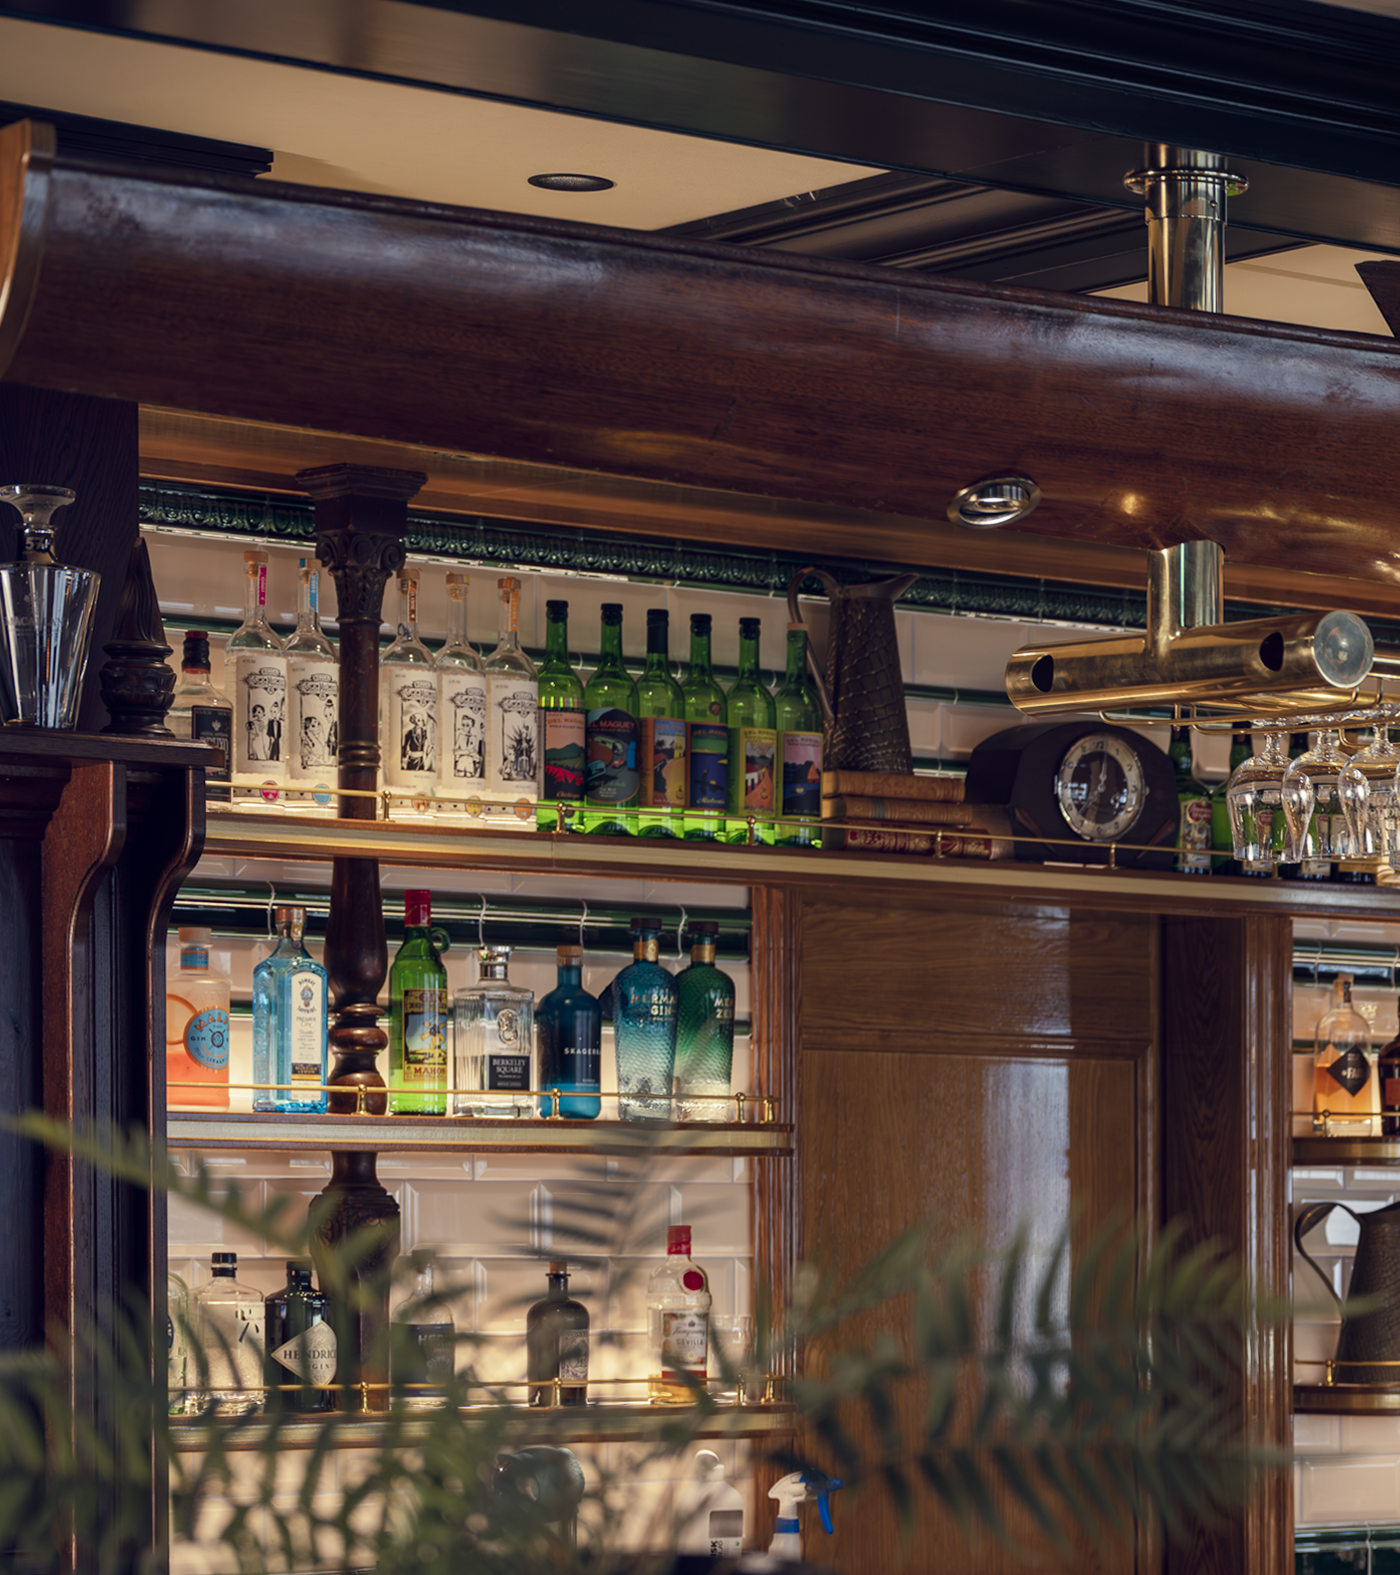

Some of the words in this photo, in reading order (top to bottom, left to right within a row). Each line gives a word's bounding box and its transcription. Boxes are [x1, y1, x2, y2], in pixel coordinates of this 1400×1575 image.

[600, 720, 635, 729] MAGUEY
[298, 978, 317, 987] BOMBAY
[419, 991, 443, 1002] GIN
[297, 1006, 317, 1015] SAPPHIRE
[650, 1004, 672, 1016] GIN
[492, 1058, 527, 1066] BERKELEY
[495, 1066, 523, 1075] SQUARE
[672, 1326, 706, 1338] Tanqueray
[675, 1338, 704, 1346] SEVILLA
